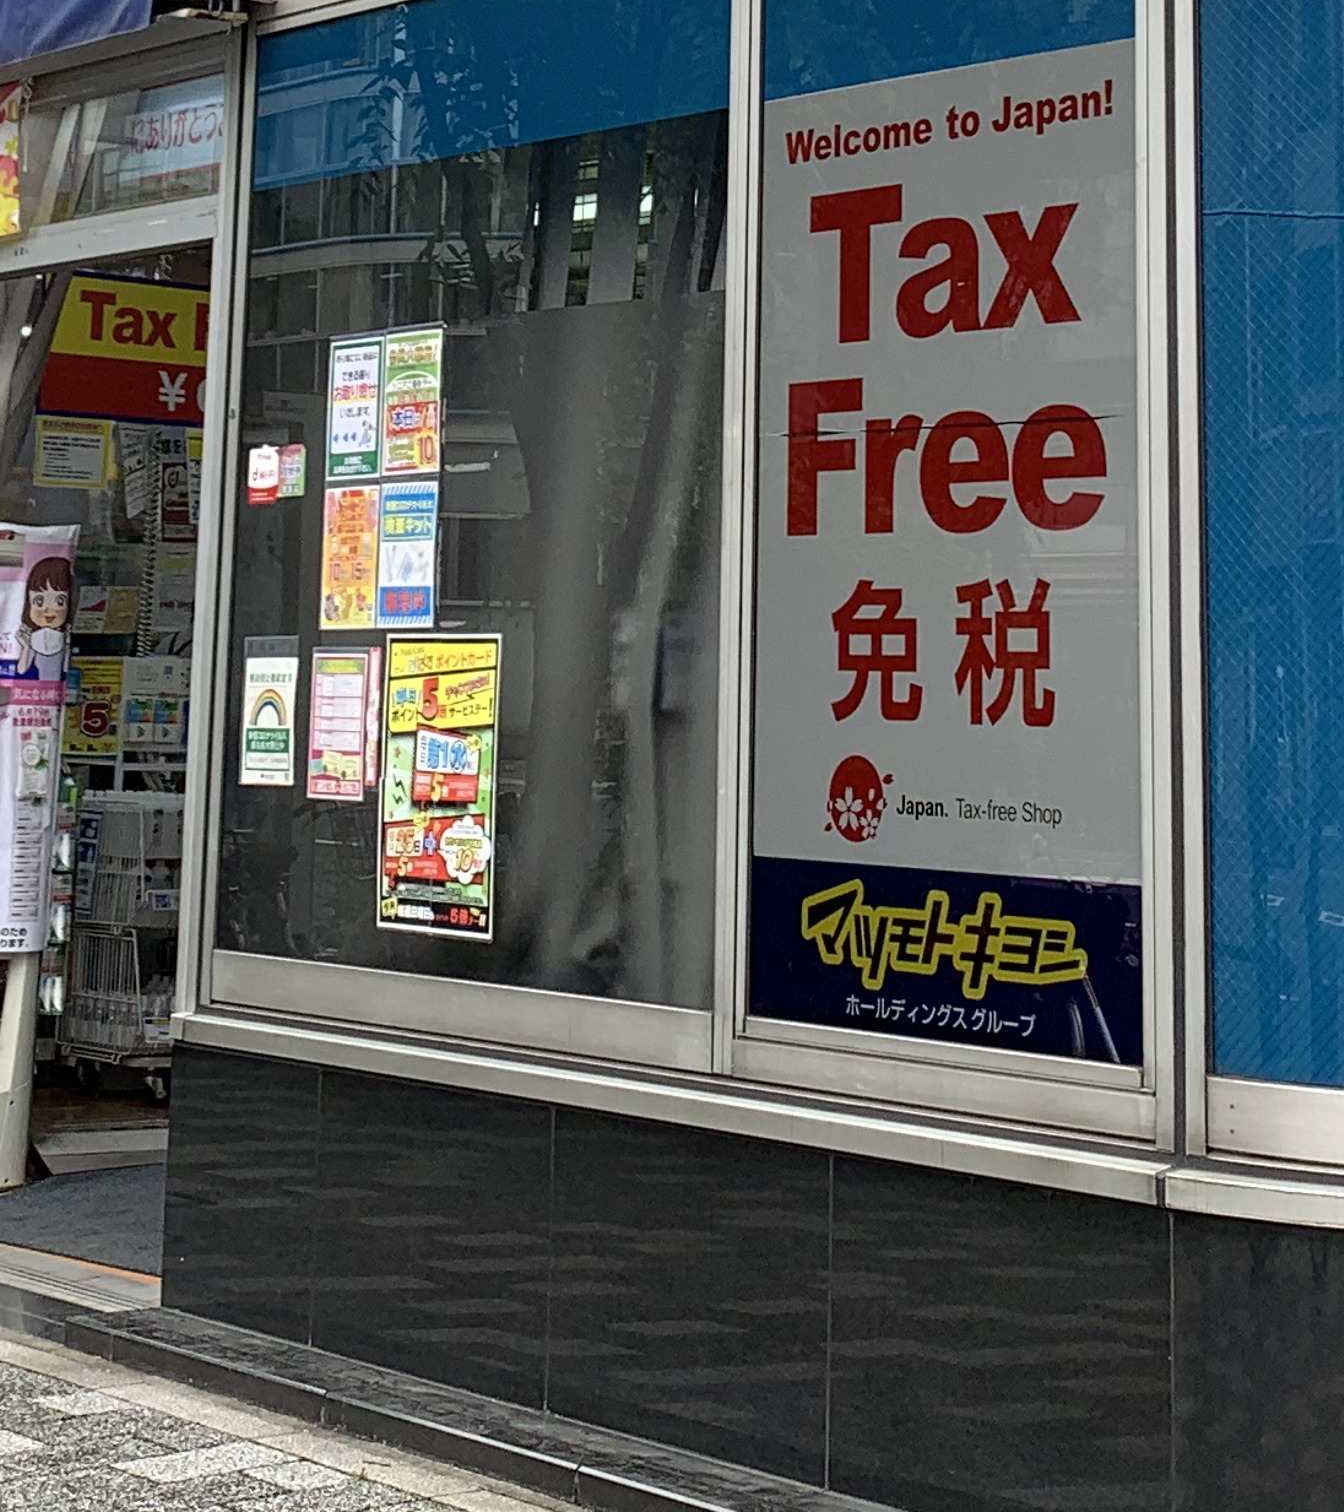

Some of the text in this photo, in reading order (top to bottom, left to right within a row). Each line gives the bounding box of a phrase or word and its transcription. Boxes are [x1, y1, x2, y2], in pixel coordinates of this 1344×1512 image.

[785, 79, 1115, 165] Welcome to Japan!
[809, 183, 1083, 344] Tax
[78, 289, 177, 351] Tax
[786, 376, 1109, 537] Free
[435, 649, 493, 670] ポイントカード
[829, 577, 1057, 728] 免税
[895, 793, 1063, 827] Japan. Tax-free Shop
[800, 878, 1089, 1001] マツモトキヨシ
